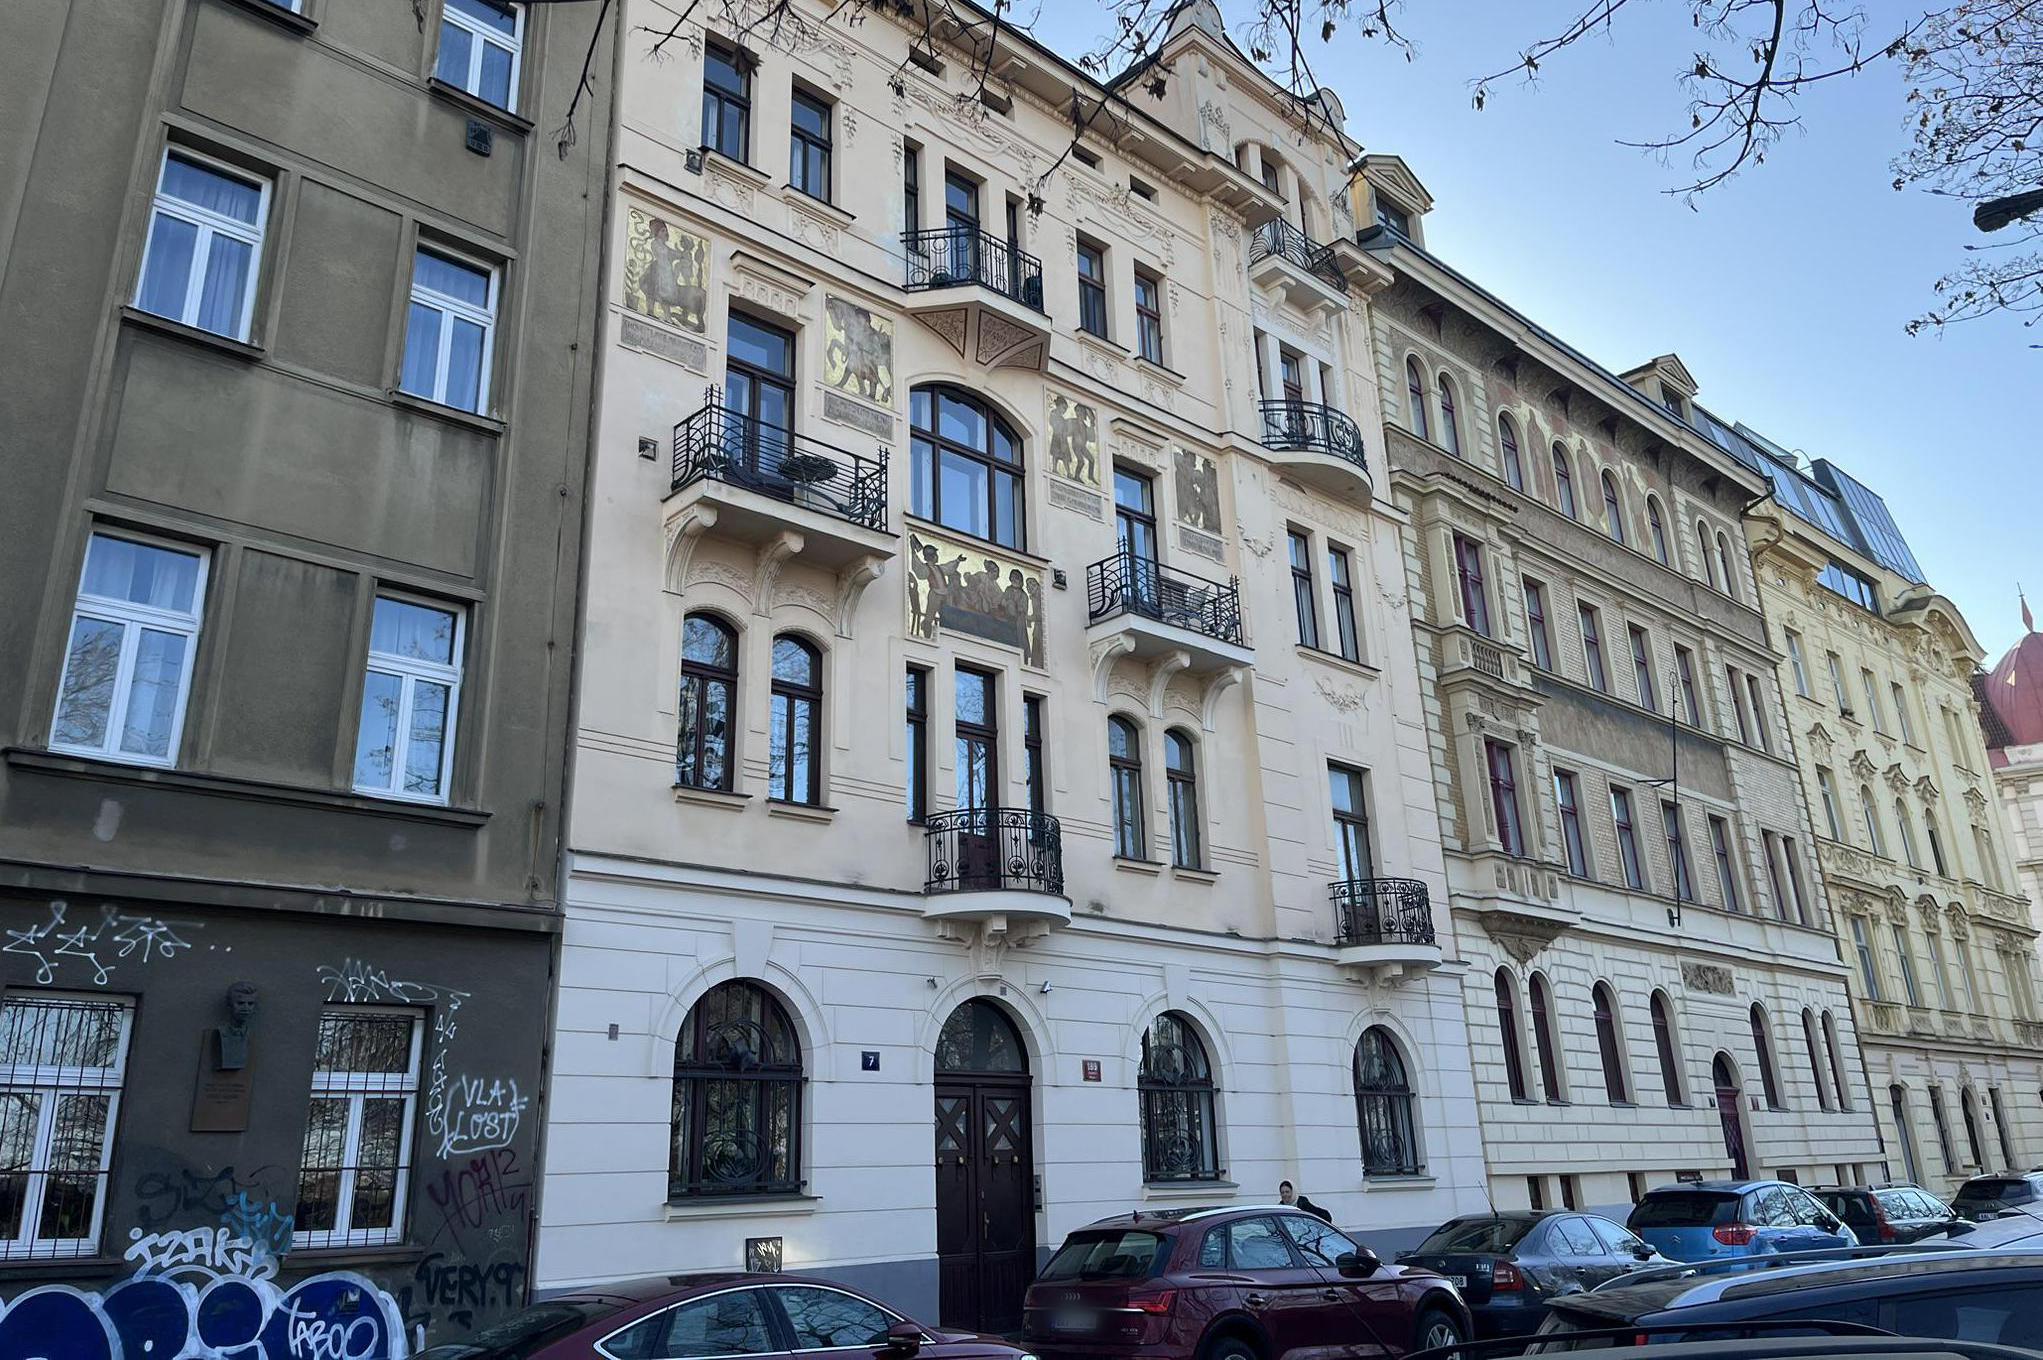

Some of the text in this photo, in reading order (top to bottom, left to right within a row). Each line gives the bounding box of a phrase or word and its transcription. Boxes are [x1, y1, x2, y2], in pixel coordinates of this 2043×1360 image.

[868, 1055, 875, 1067] 7
[462, 1075, 506, 1108] VLA
[279, 1296, 380, 1360] TABOO
